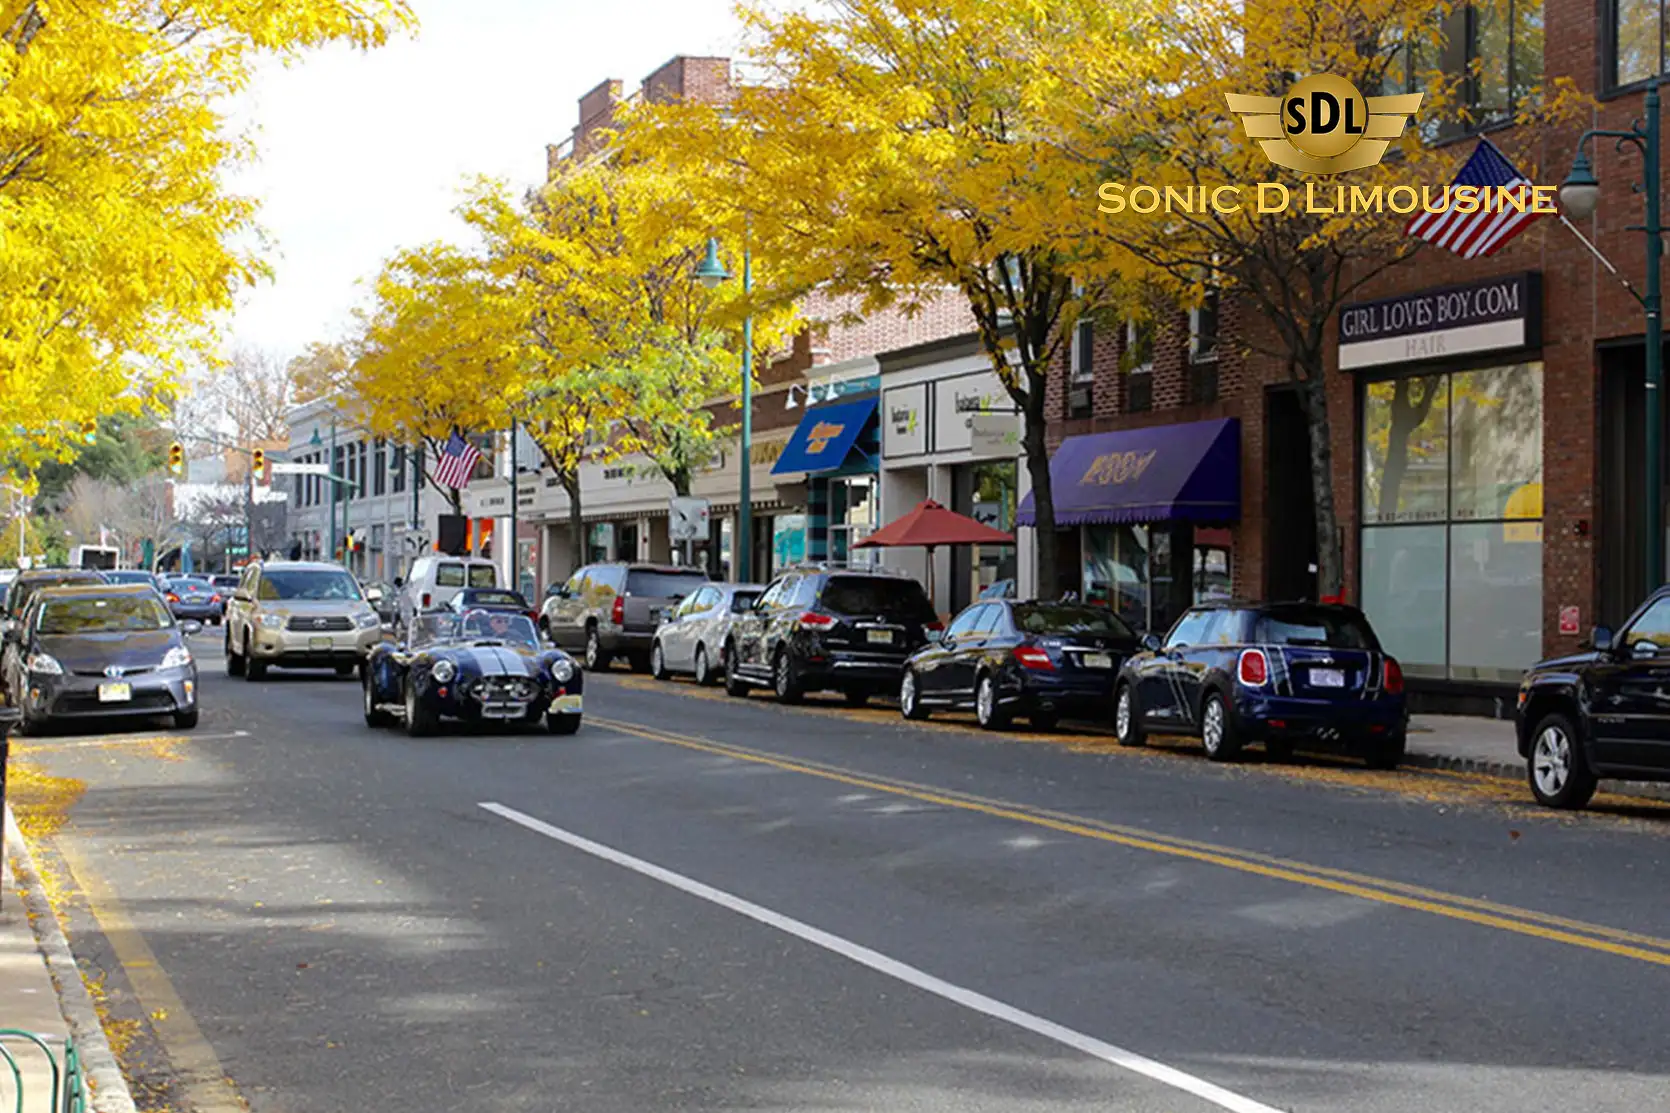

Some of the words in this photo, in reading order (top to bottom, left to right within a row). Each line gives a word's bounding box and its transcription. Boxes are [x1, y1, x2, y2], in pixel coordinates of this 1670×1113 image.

[1342, 306, 1379, 337] GIRL
[1383, 298, 1433, 332] LOVES
[1437, 283, 1520, 323] BOY.COM
[1405, 335, 1446, 358] HAIR
